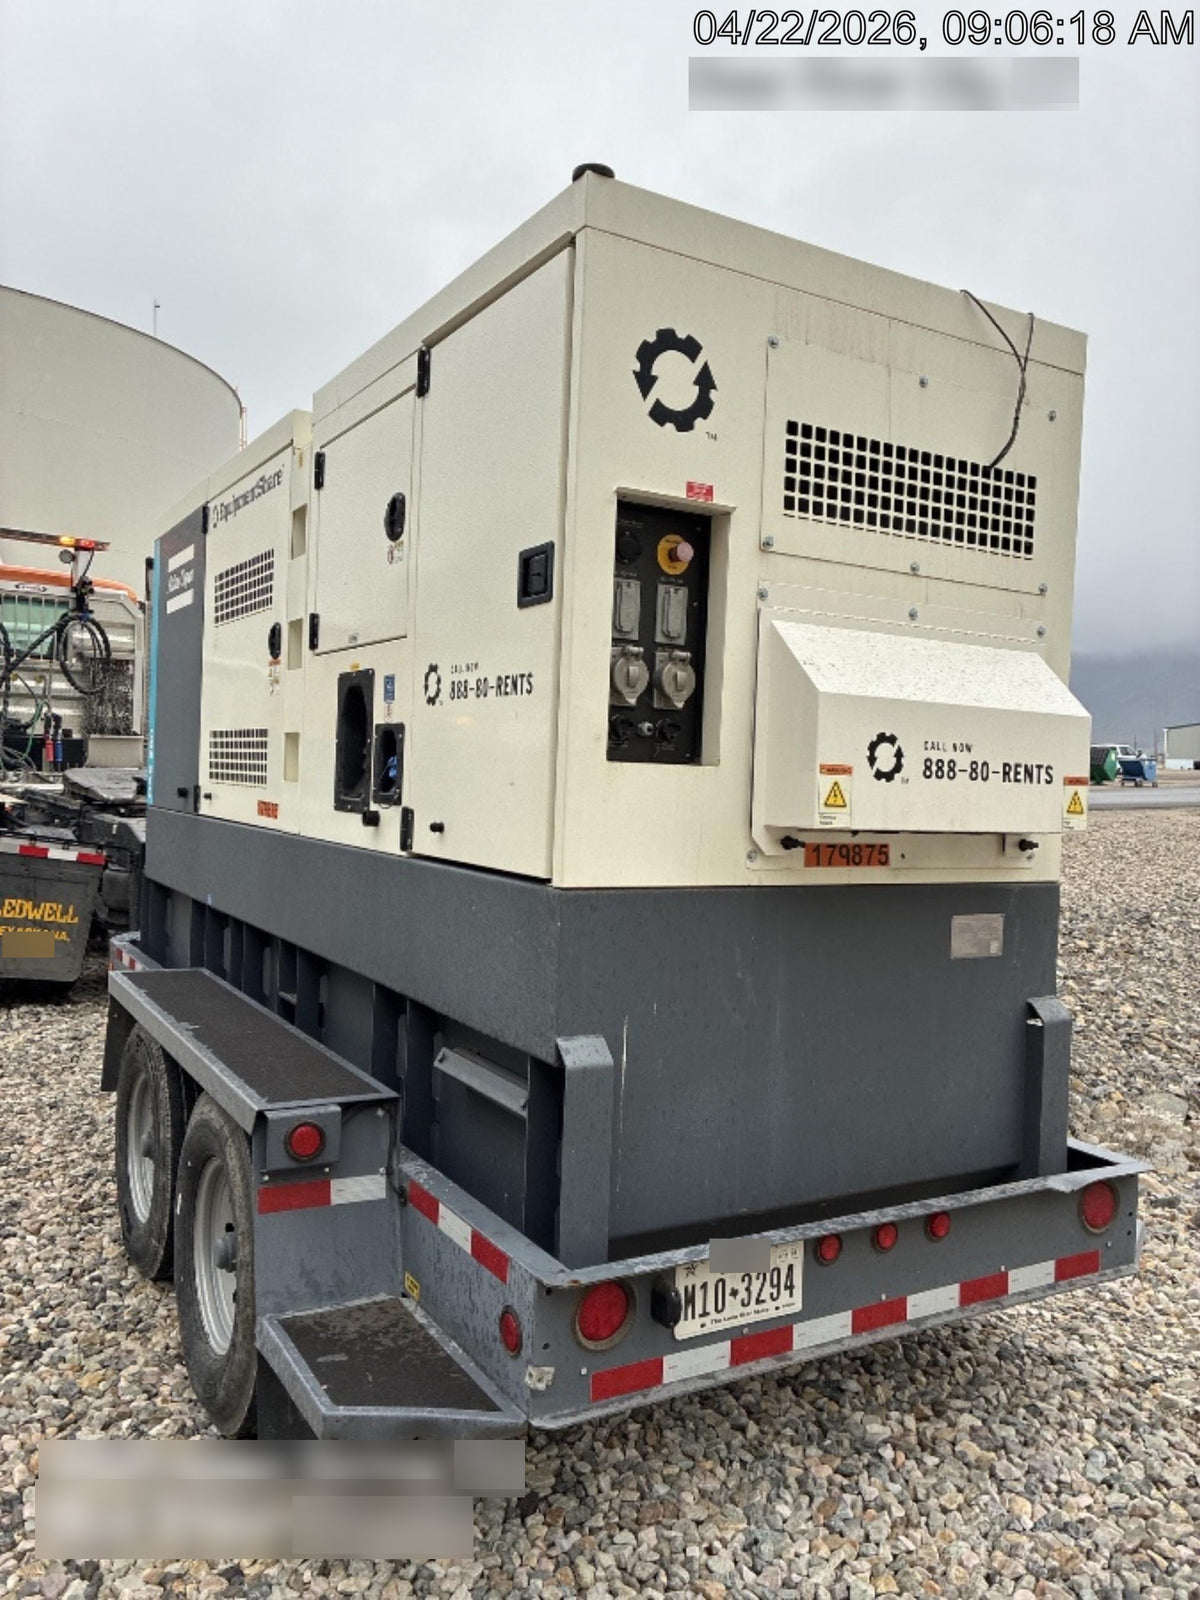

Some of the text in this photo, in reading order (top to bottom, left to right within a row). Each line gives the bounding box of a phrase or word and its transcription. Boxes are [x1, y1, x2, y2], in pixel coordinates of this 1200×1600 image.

[449, 672, 534, 701] 888-80-RENTS
[923, 740, 974, 754] CALL NOW
[922, 757, 1054, 785] 888-80-RENTS
[812, 843, 890, 867] 179875
